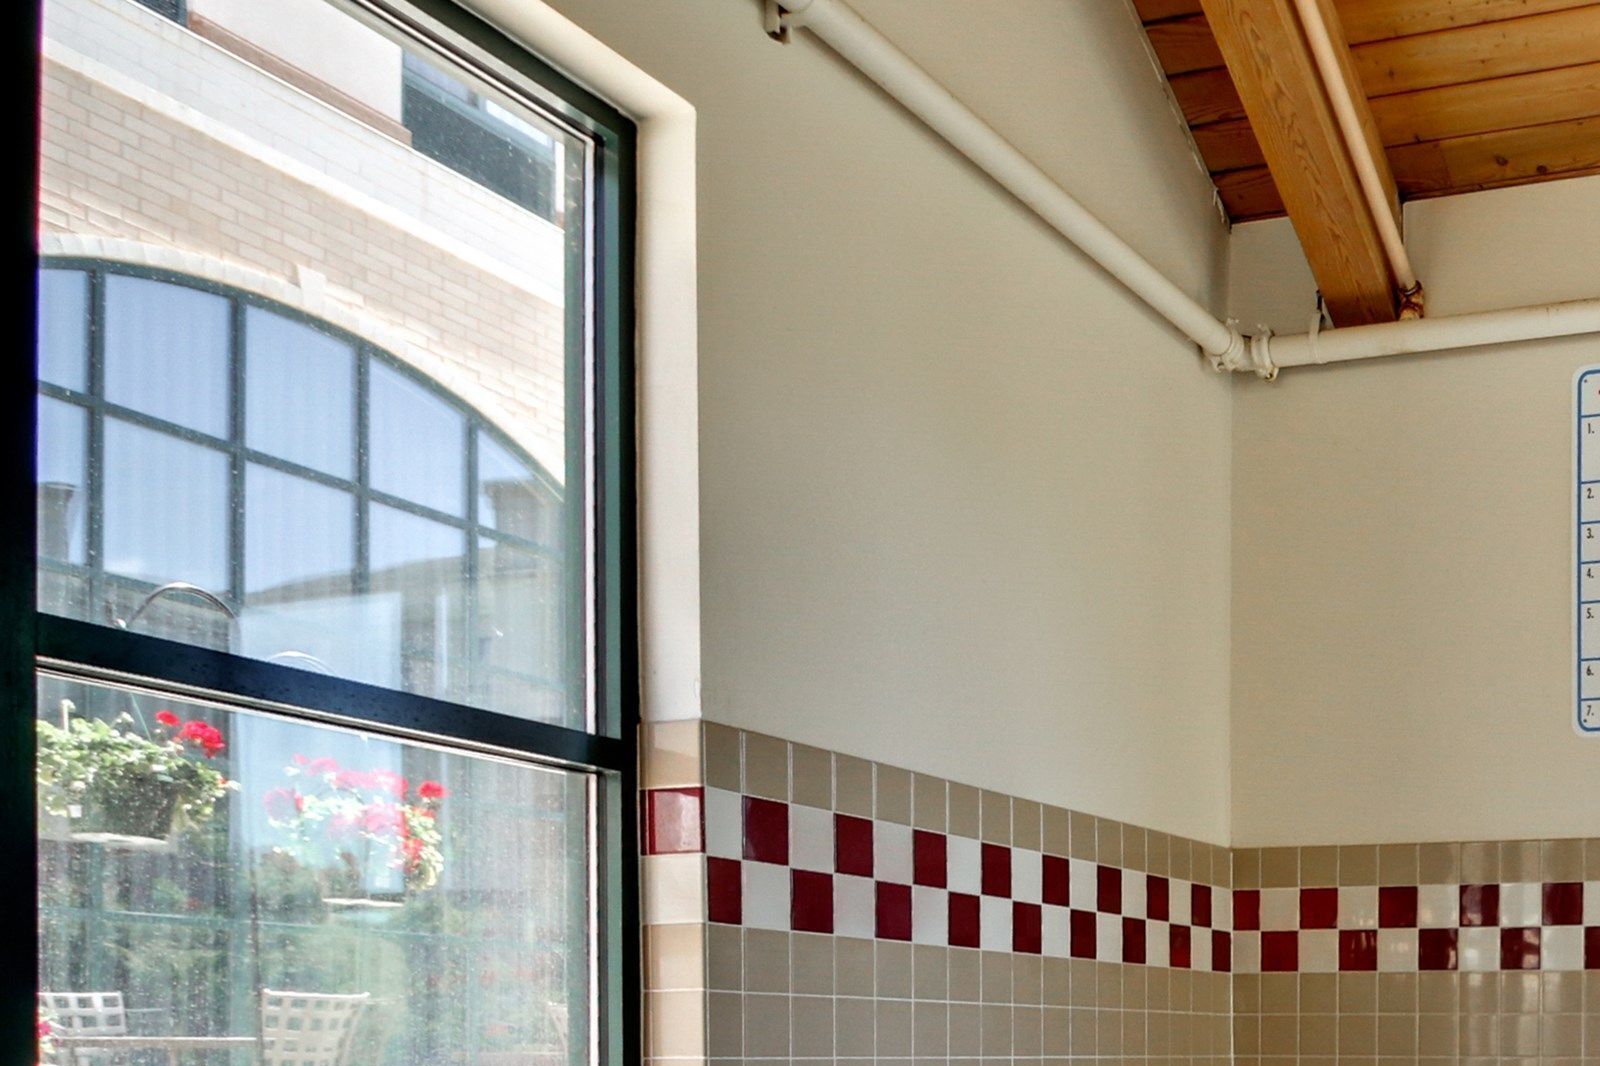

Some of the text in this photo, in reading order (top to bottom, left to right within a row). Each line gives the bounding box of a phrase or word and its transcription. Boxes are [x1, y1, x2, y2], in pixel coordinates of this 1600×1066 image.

[1588, 424, 1594, 434] 1.
[1587, 489, 1594, 499] 2.
[1586, 529, 1594, 539] 3.
[1586, 569, 1594, 578] 4.
[1586, 608, 1594, 619] 5.
[1586, 666, 1594, 676] 6.
[1587, 706, 1594, 716] 7.
